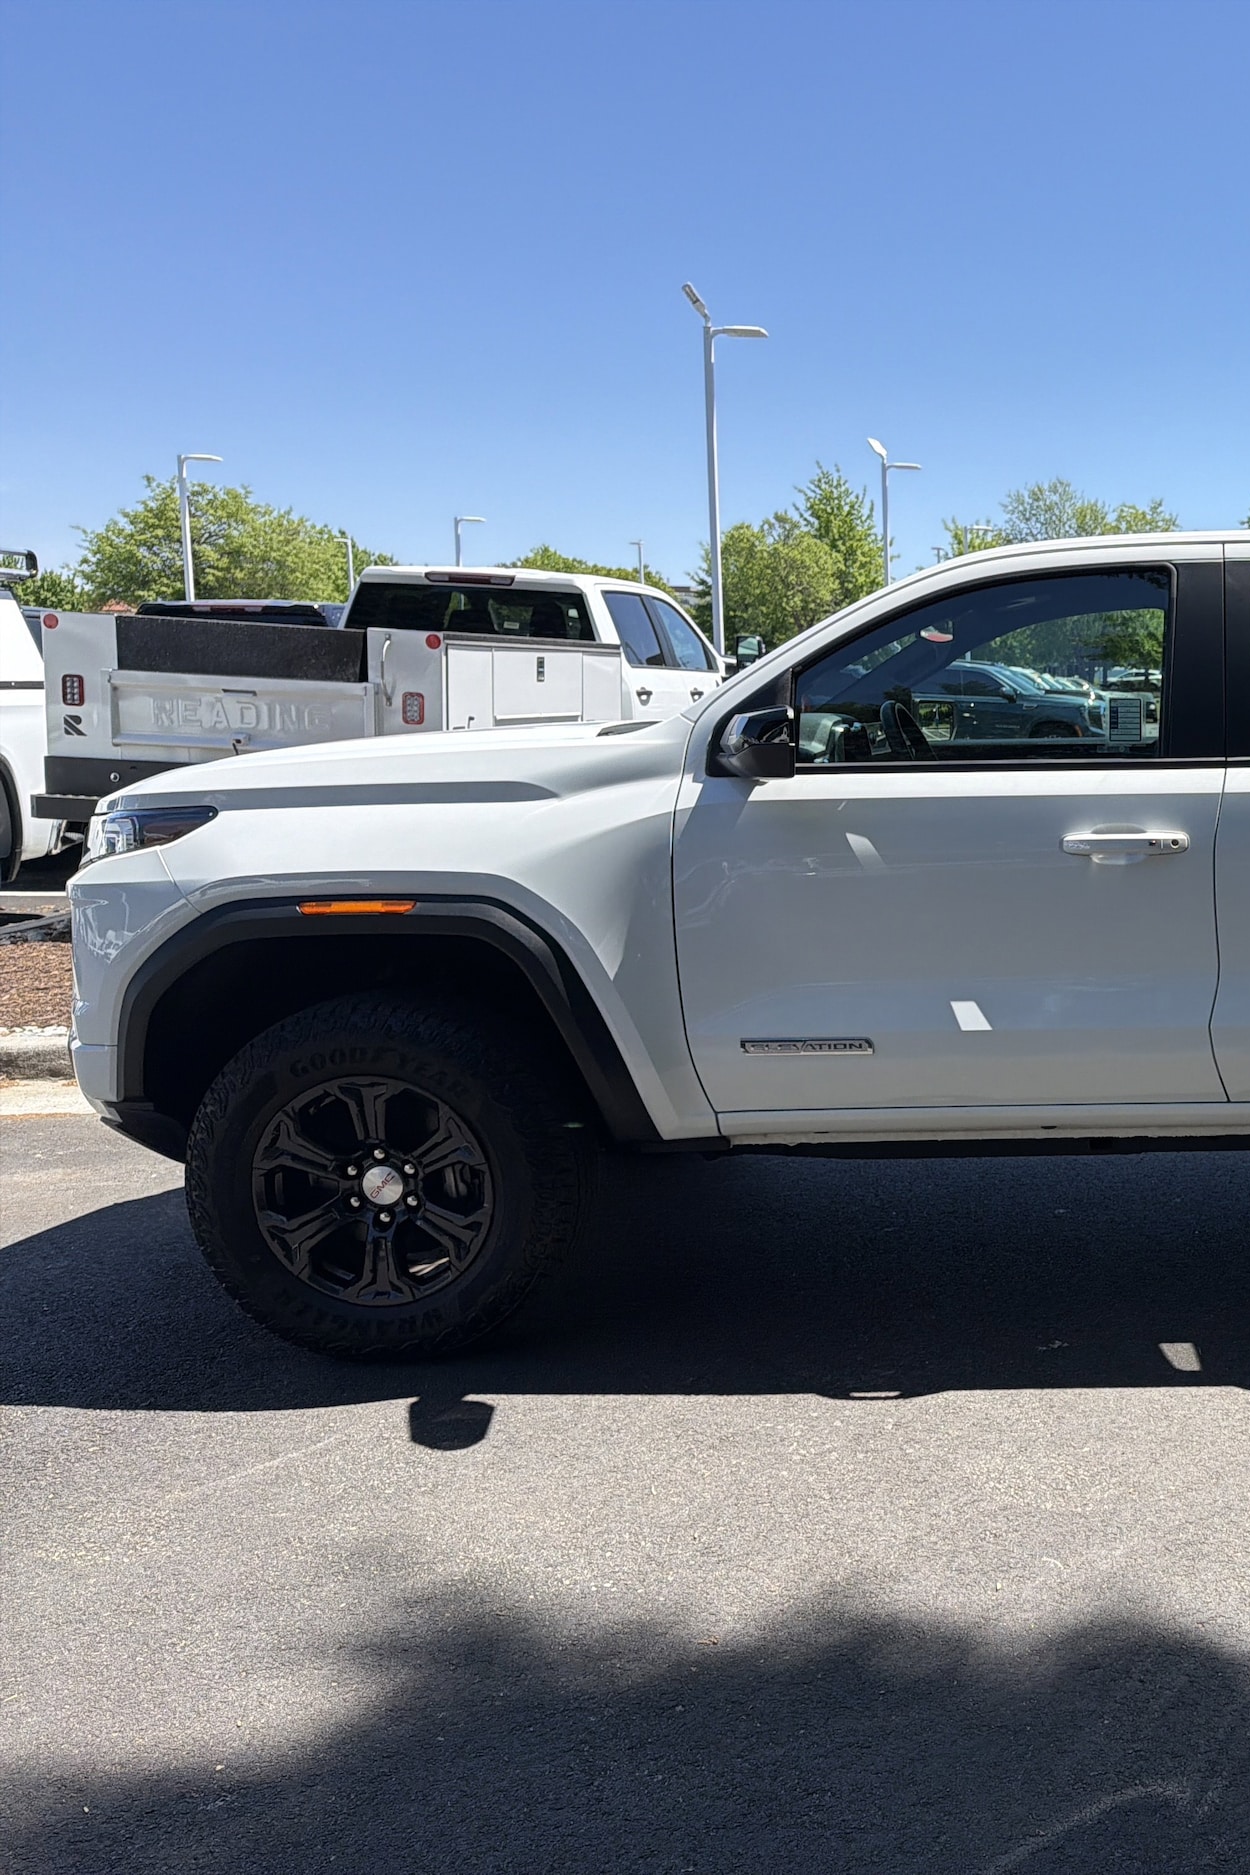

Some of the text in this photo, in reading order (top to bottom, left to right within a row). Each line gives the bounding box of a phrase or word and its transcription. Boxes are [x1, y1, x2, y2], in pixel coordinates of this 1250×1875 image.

[151, 698, 331, 730] READING
[750, 1042, 864, 1051] ELEVATION
[370, 1171, 396, 1199] GMC
